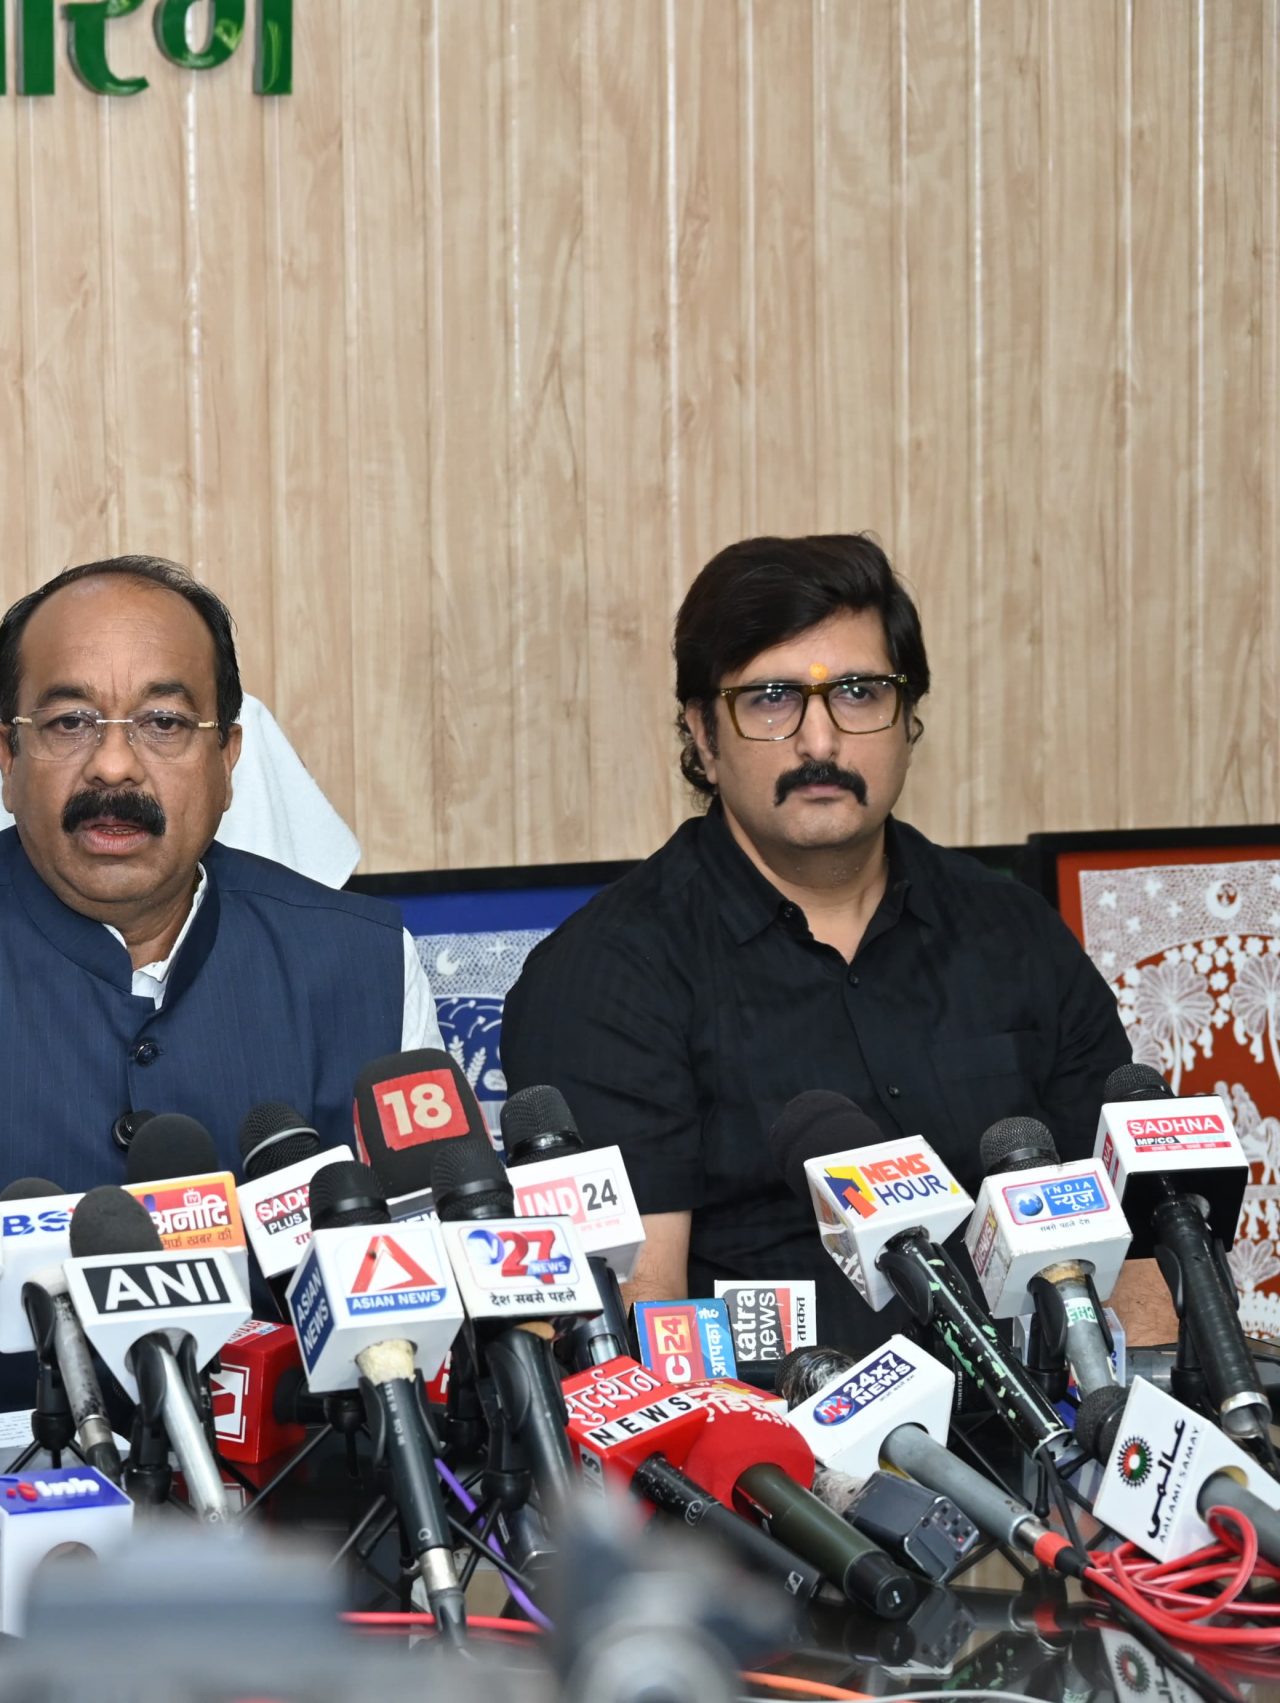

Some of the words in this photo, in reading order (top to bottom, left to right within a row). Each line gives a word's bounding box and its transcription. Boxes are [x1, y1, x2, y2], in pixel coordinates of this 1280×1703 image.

[383, 1083, 452, 1136] 18
[1130, 1117, 1222, 1135] SADHNA
[1136, 1137, 1175, 1146] MP/CG
[860, 1153, 931, 1185] NEWS
[257, 1186, 310, 1222] SADH
[523, 1184, 584, 1217] IND
[582, 1179, 618, 1212] 24
[874, 1174, 948, 1206] HOUR
[1045, 1181, 1092, 1195] INDIA
[270, 1213, 303, 1234] PLUS
[530, 1260, 568, 1273] NEWS
[105, 1261, 221, 1311] ANI
[296, 1267, 322, 1328] ASIAN
[352, 1295, 395, 1310] ASIAN
[398, 1290, 441, 1305] NEWS
[490, 1290, 512, 1307] देश
[515, 1288, 545, 1304] सबसे
[549, 1287, 577, 1303] पहले
[303, 1298, 330, 1356] NEWS
[758, 1291, 776, 1361] news
[822, 1397, 852, 1424] JK
[842, 1353, 899, 1398] 24x7
[855, 1362, 912, 1406] NEWS
[589, 1396, 692, 1446] NEWS
[1179, 1425, 1200, 1477] SAMAY
